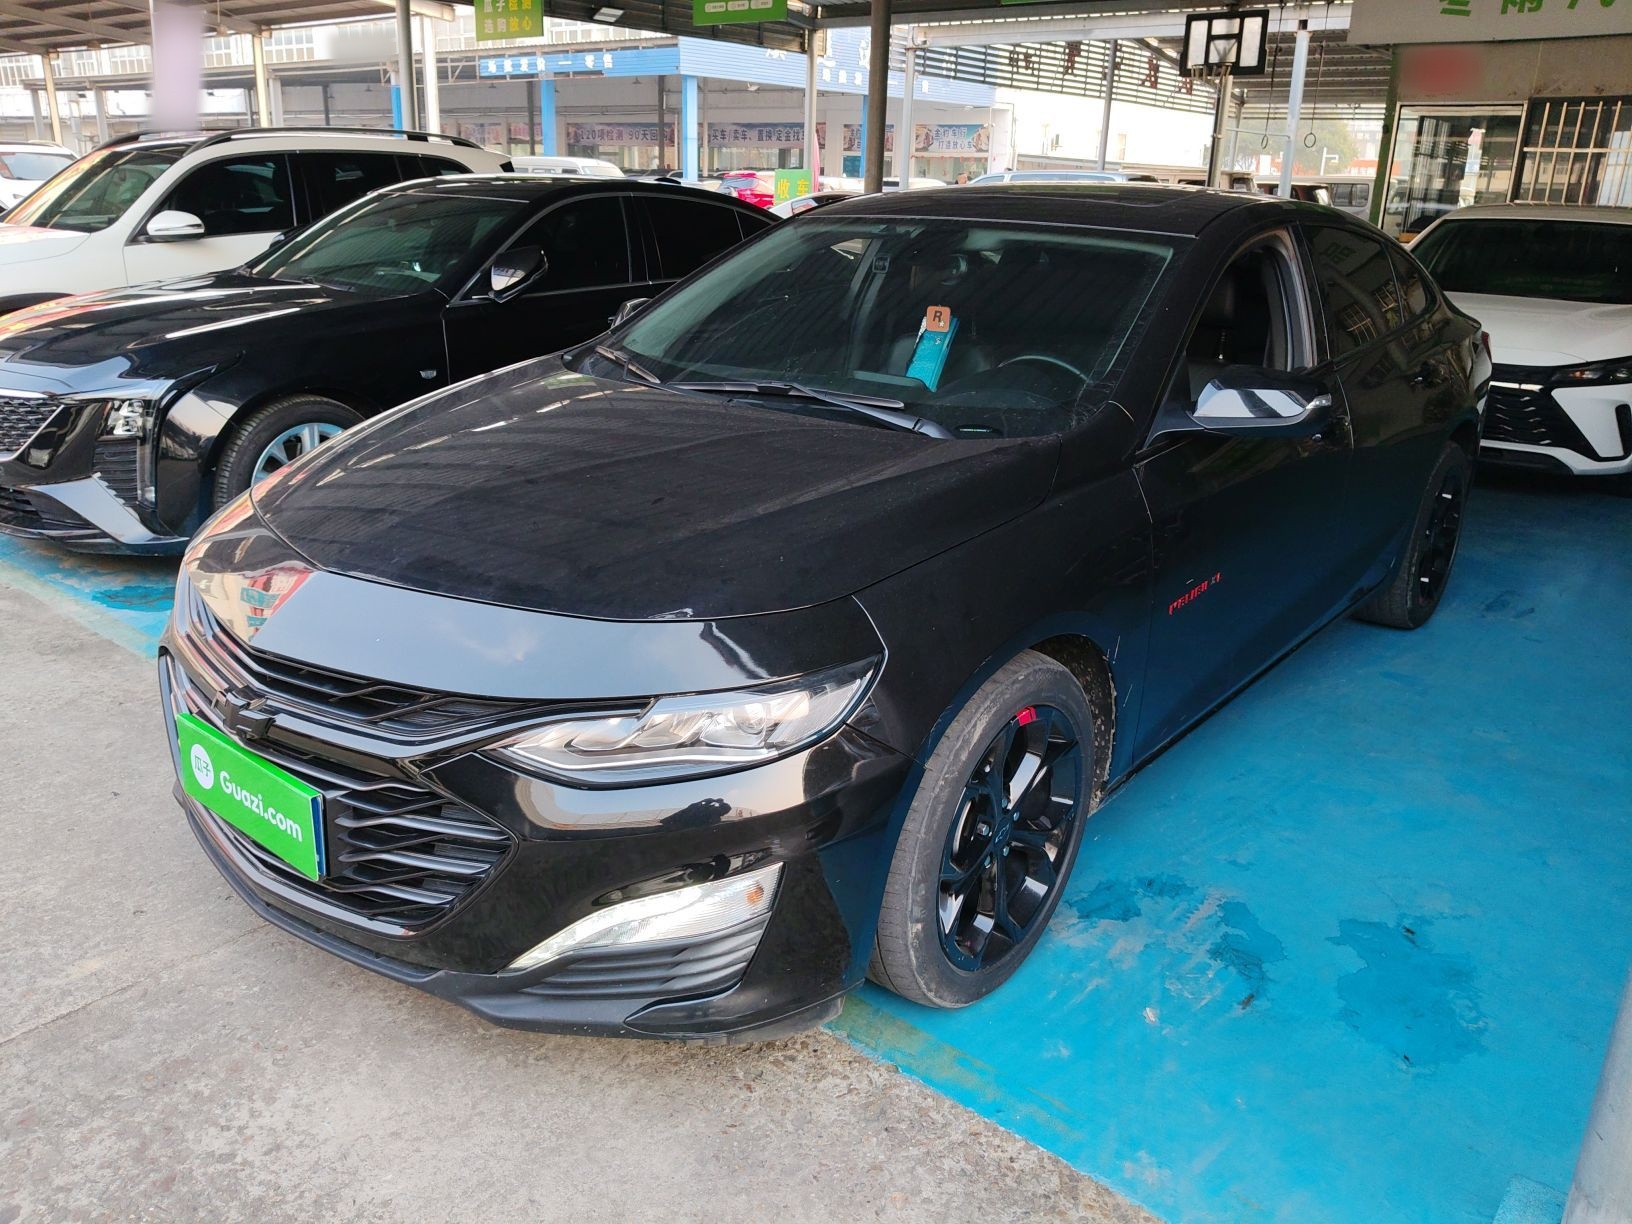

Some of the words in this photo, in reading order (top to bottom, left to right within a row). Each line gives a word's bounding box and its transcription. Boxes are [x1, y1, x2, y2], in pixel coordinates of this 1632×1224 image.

[777, 178, 810, 199] 收车
[932, 310, 943, 323] R
[194, 754, 211, 778] 瓜子
[218, 770, 303, 842] Guazi.com
